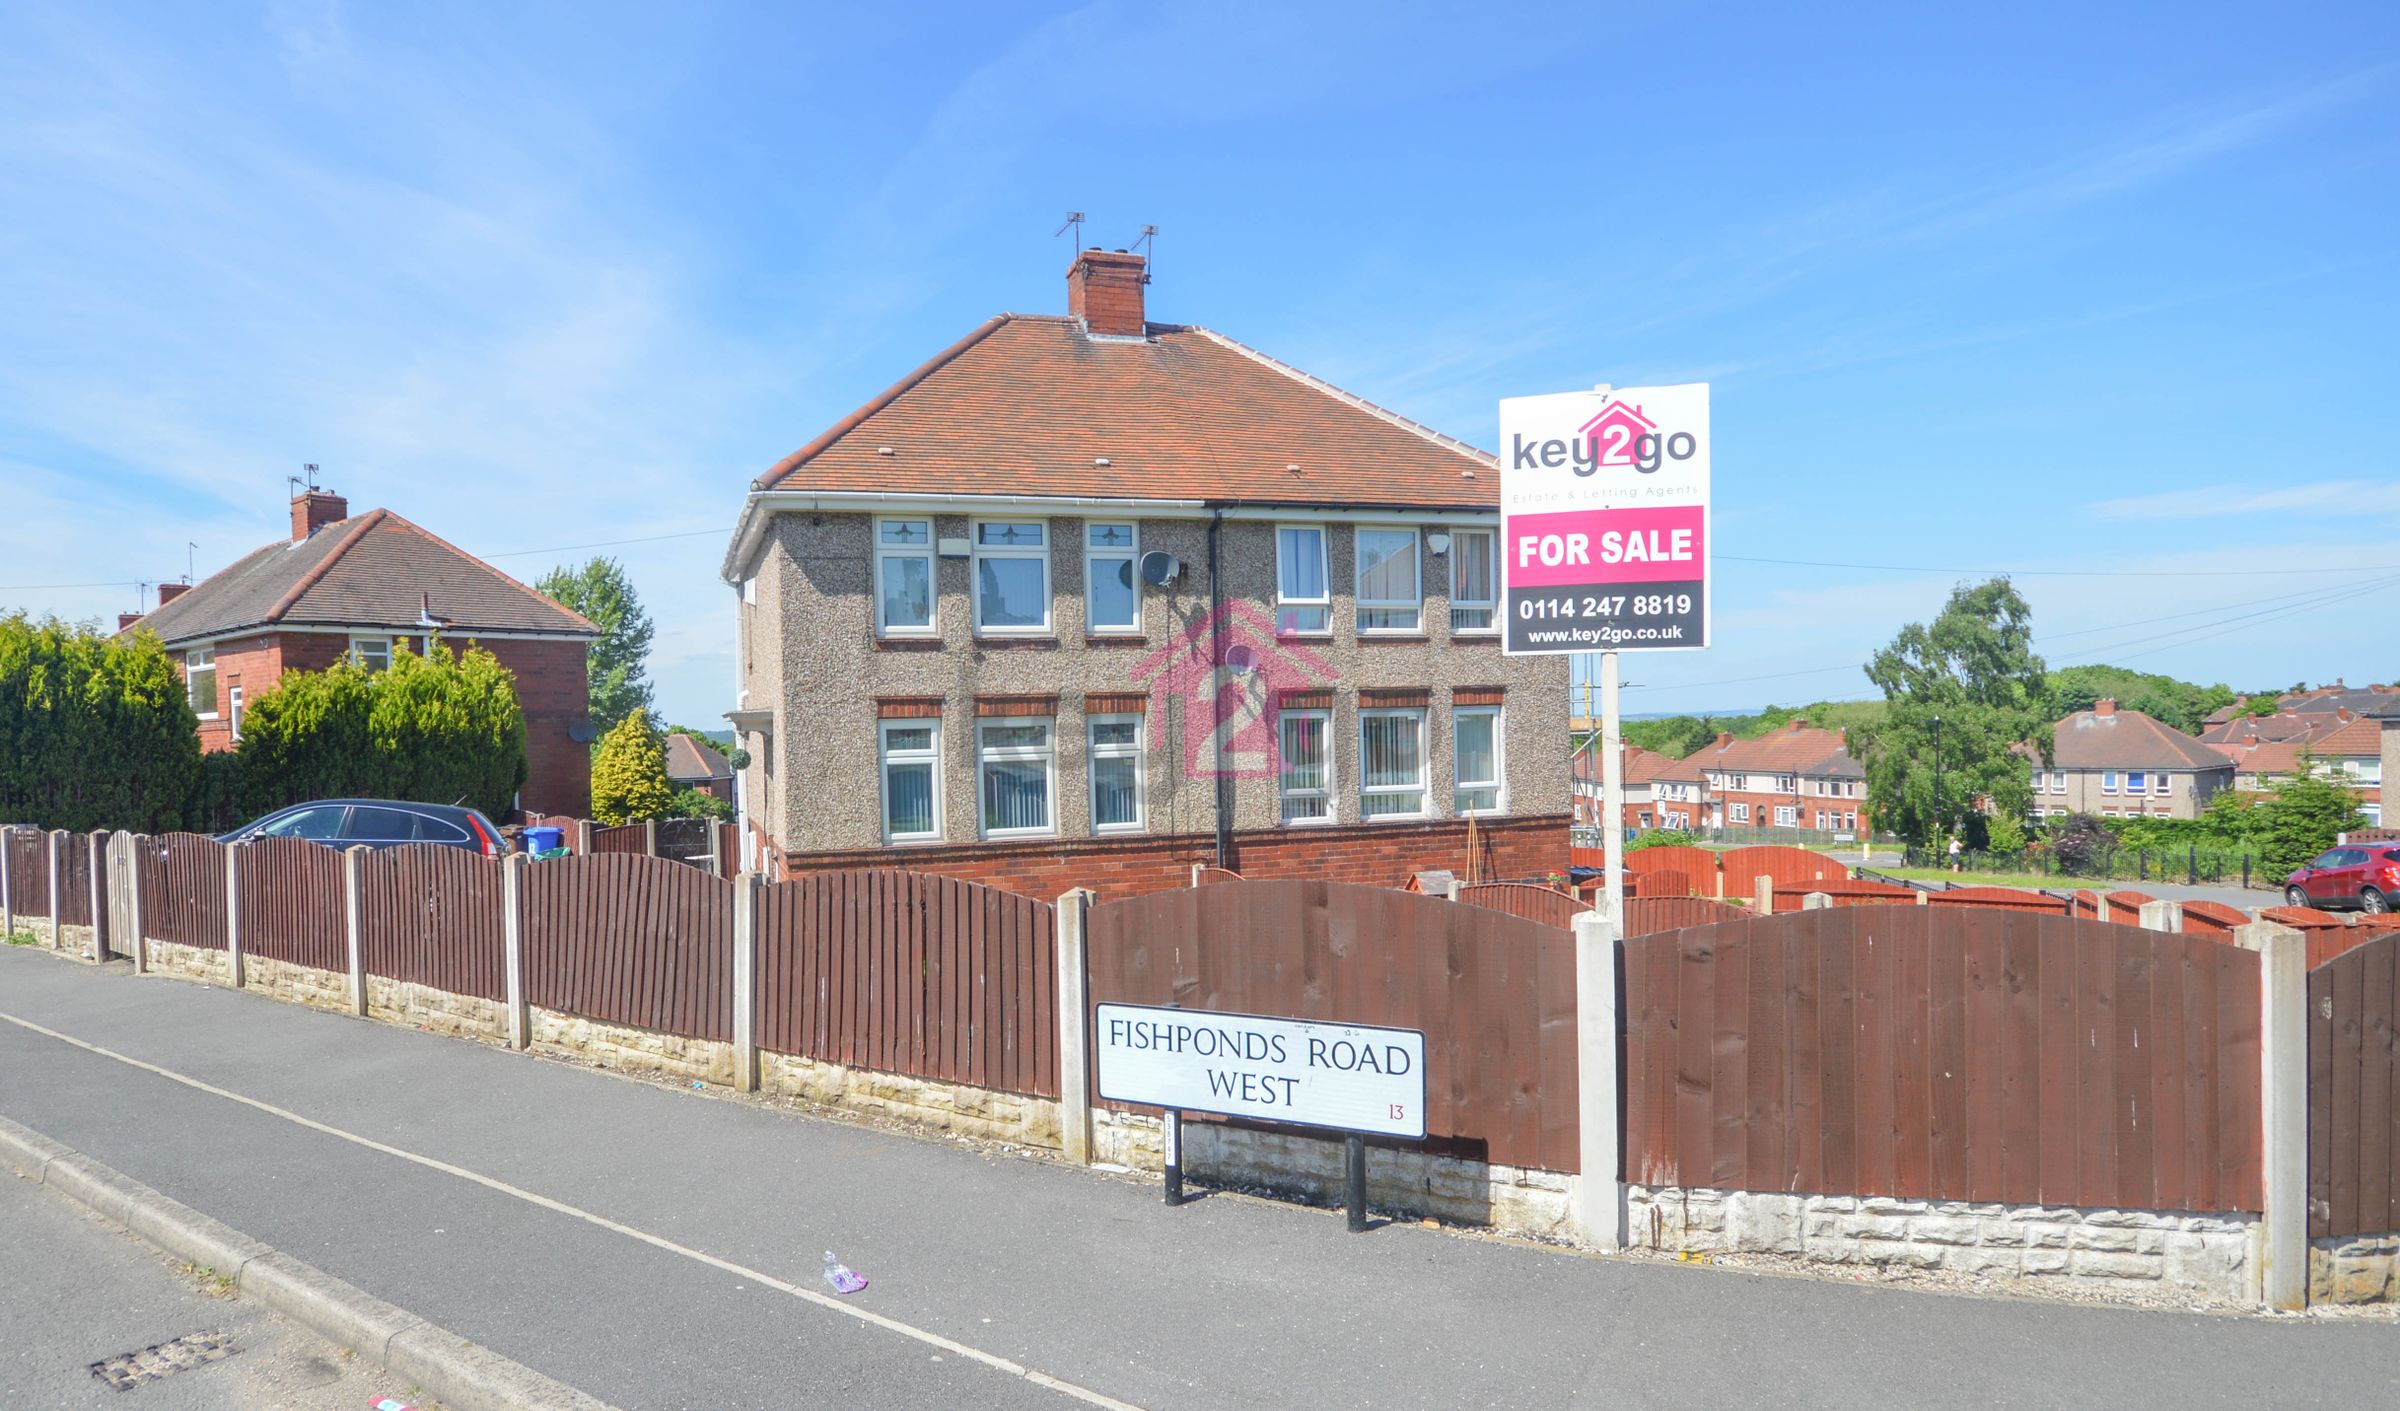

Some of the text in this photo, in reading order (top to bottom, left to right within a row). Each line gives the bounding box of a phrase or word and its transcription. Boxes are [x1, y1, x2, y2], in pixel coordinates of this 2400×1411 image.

[1513, 425, 1697, 477] key2go
[1513, 494, 1558, 504] Estate
[1583, 486, 1638, 500] Letting
[1646, 485, 1699, 497] Agents
[1519, 529, 1693, 568] FOR SALE
[1519, 594, 1692, 619] 0114 247 8819
[1528, 624, 1683, 644] www.key2go.co.uk
[1110, 1019, 1411, 1076] FISHPONDS ROAD
[1207, 1068, 1300, 1106] WEST
[1389, 1103, 1405, 1121] 13
